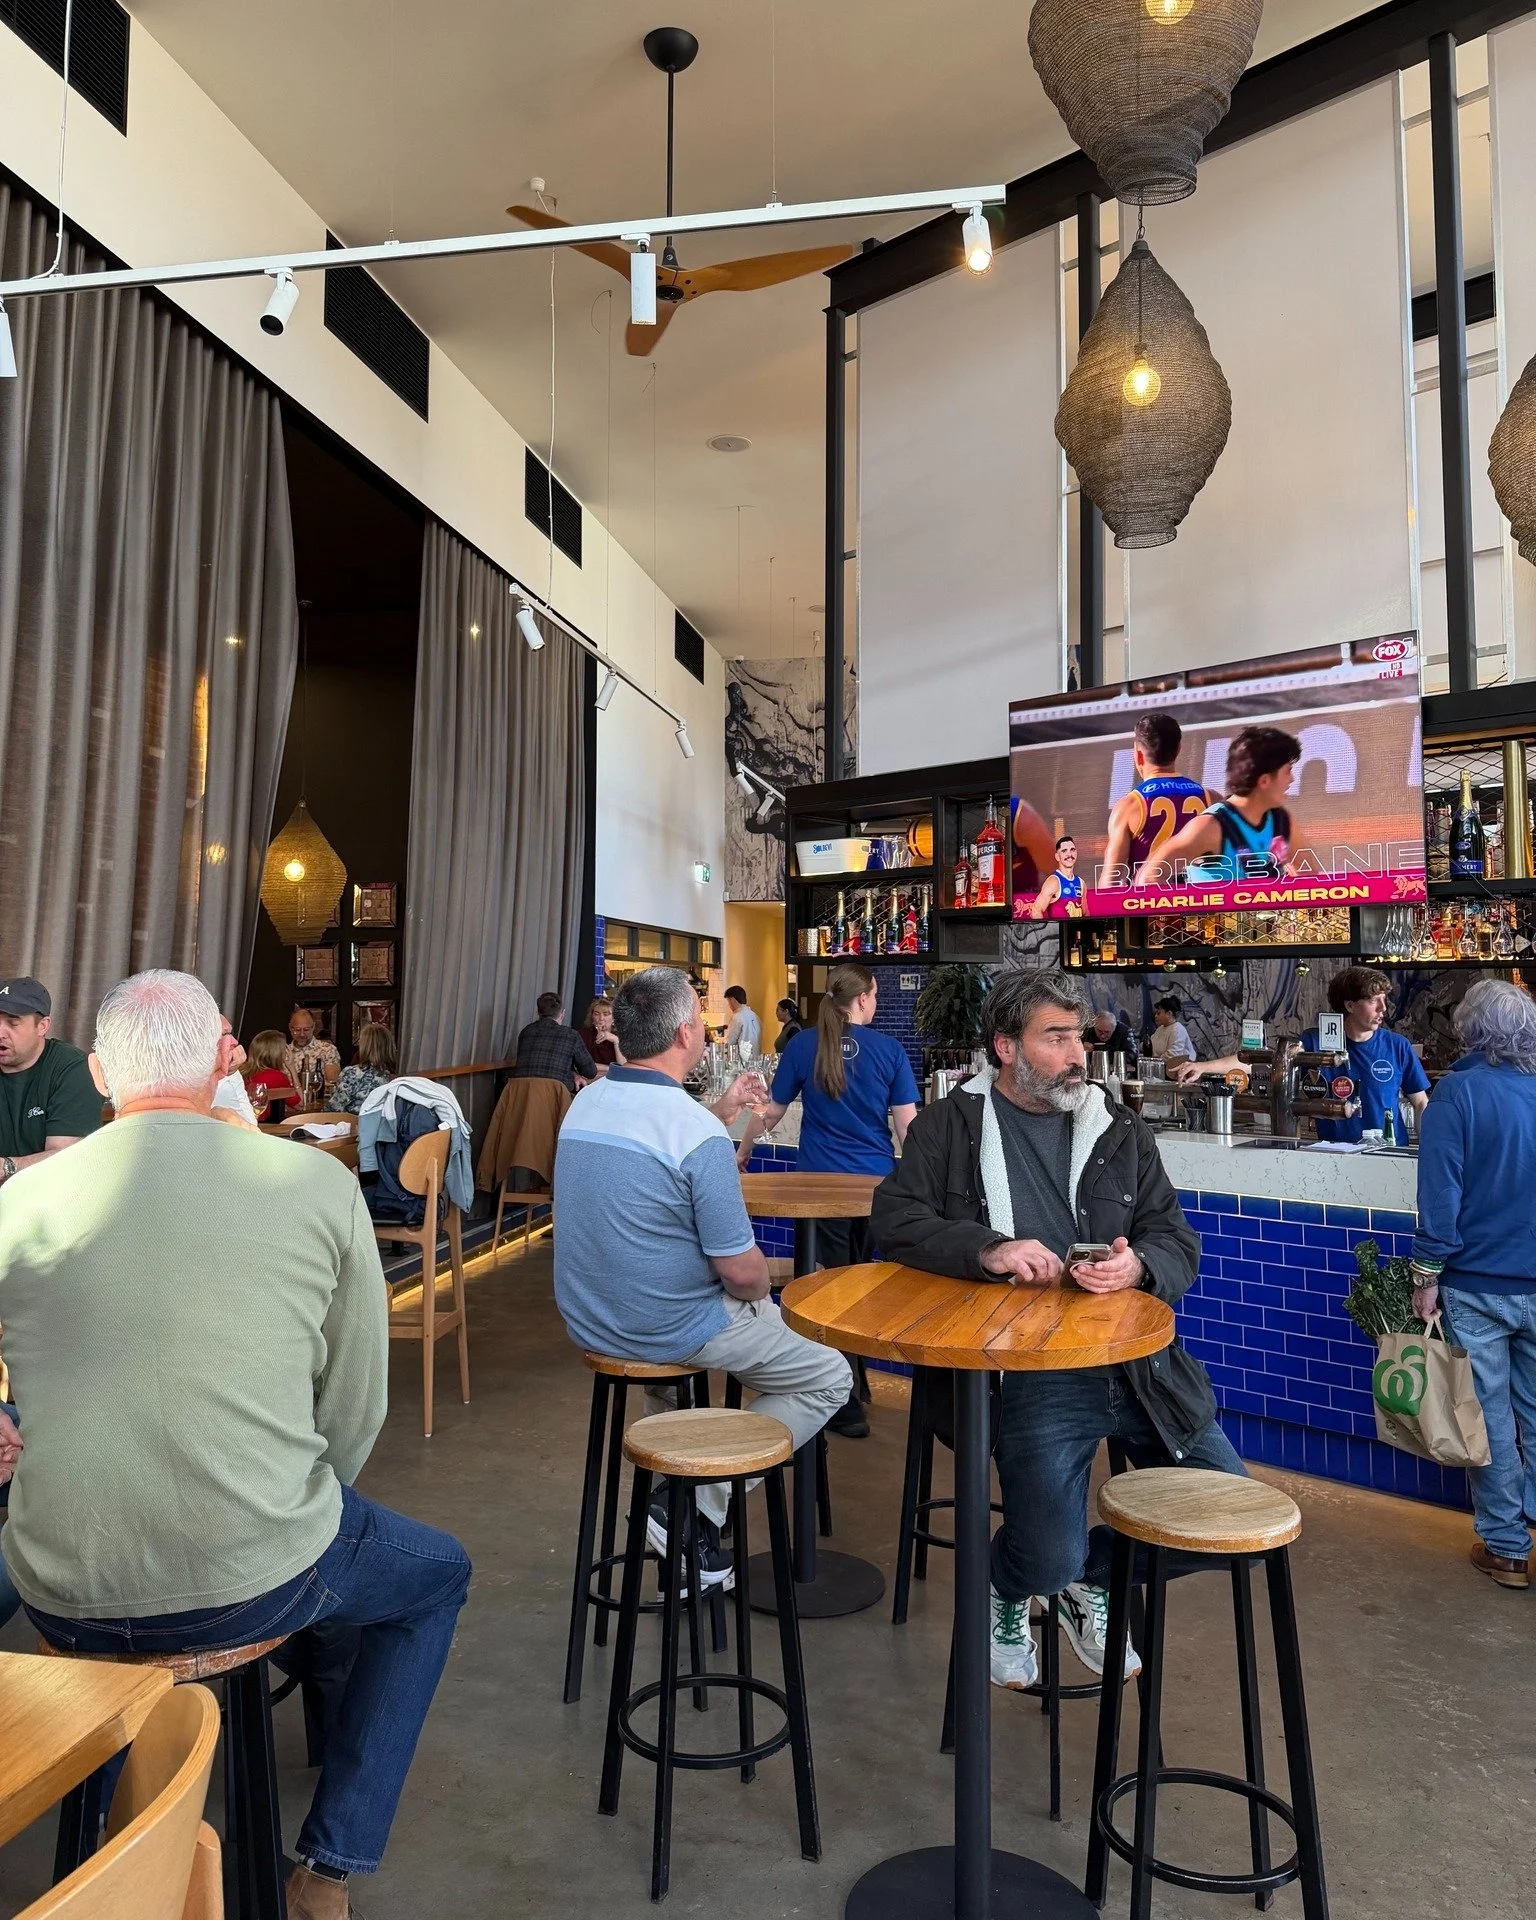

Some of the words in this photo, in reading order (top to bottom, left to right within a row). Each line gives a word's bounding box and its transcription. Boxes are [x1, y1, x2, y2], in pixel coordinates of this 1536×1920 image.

[1378, 644, 1402, 658] FOX
[1381, 670, 1400, 679] LIVE
[1094, 839, 1426, 896] BRISBANE
[1123, 893, 1224, 910] CHARLIE
[1233, 885, 1369, 905] CAMERON
[1325, 1022, 1338, 1036] JR
